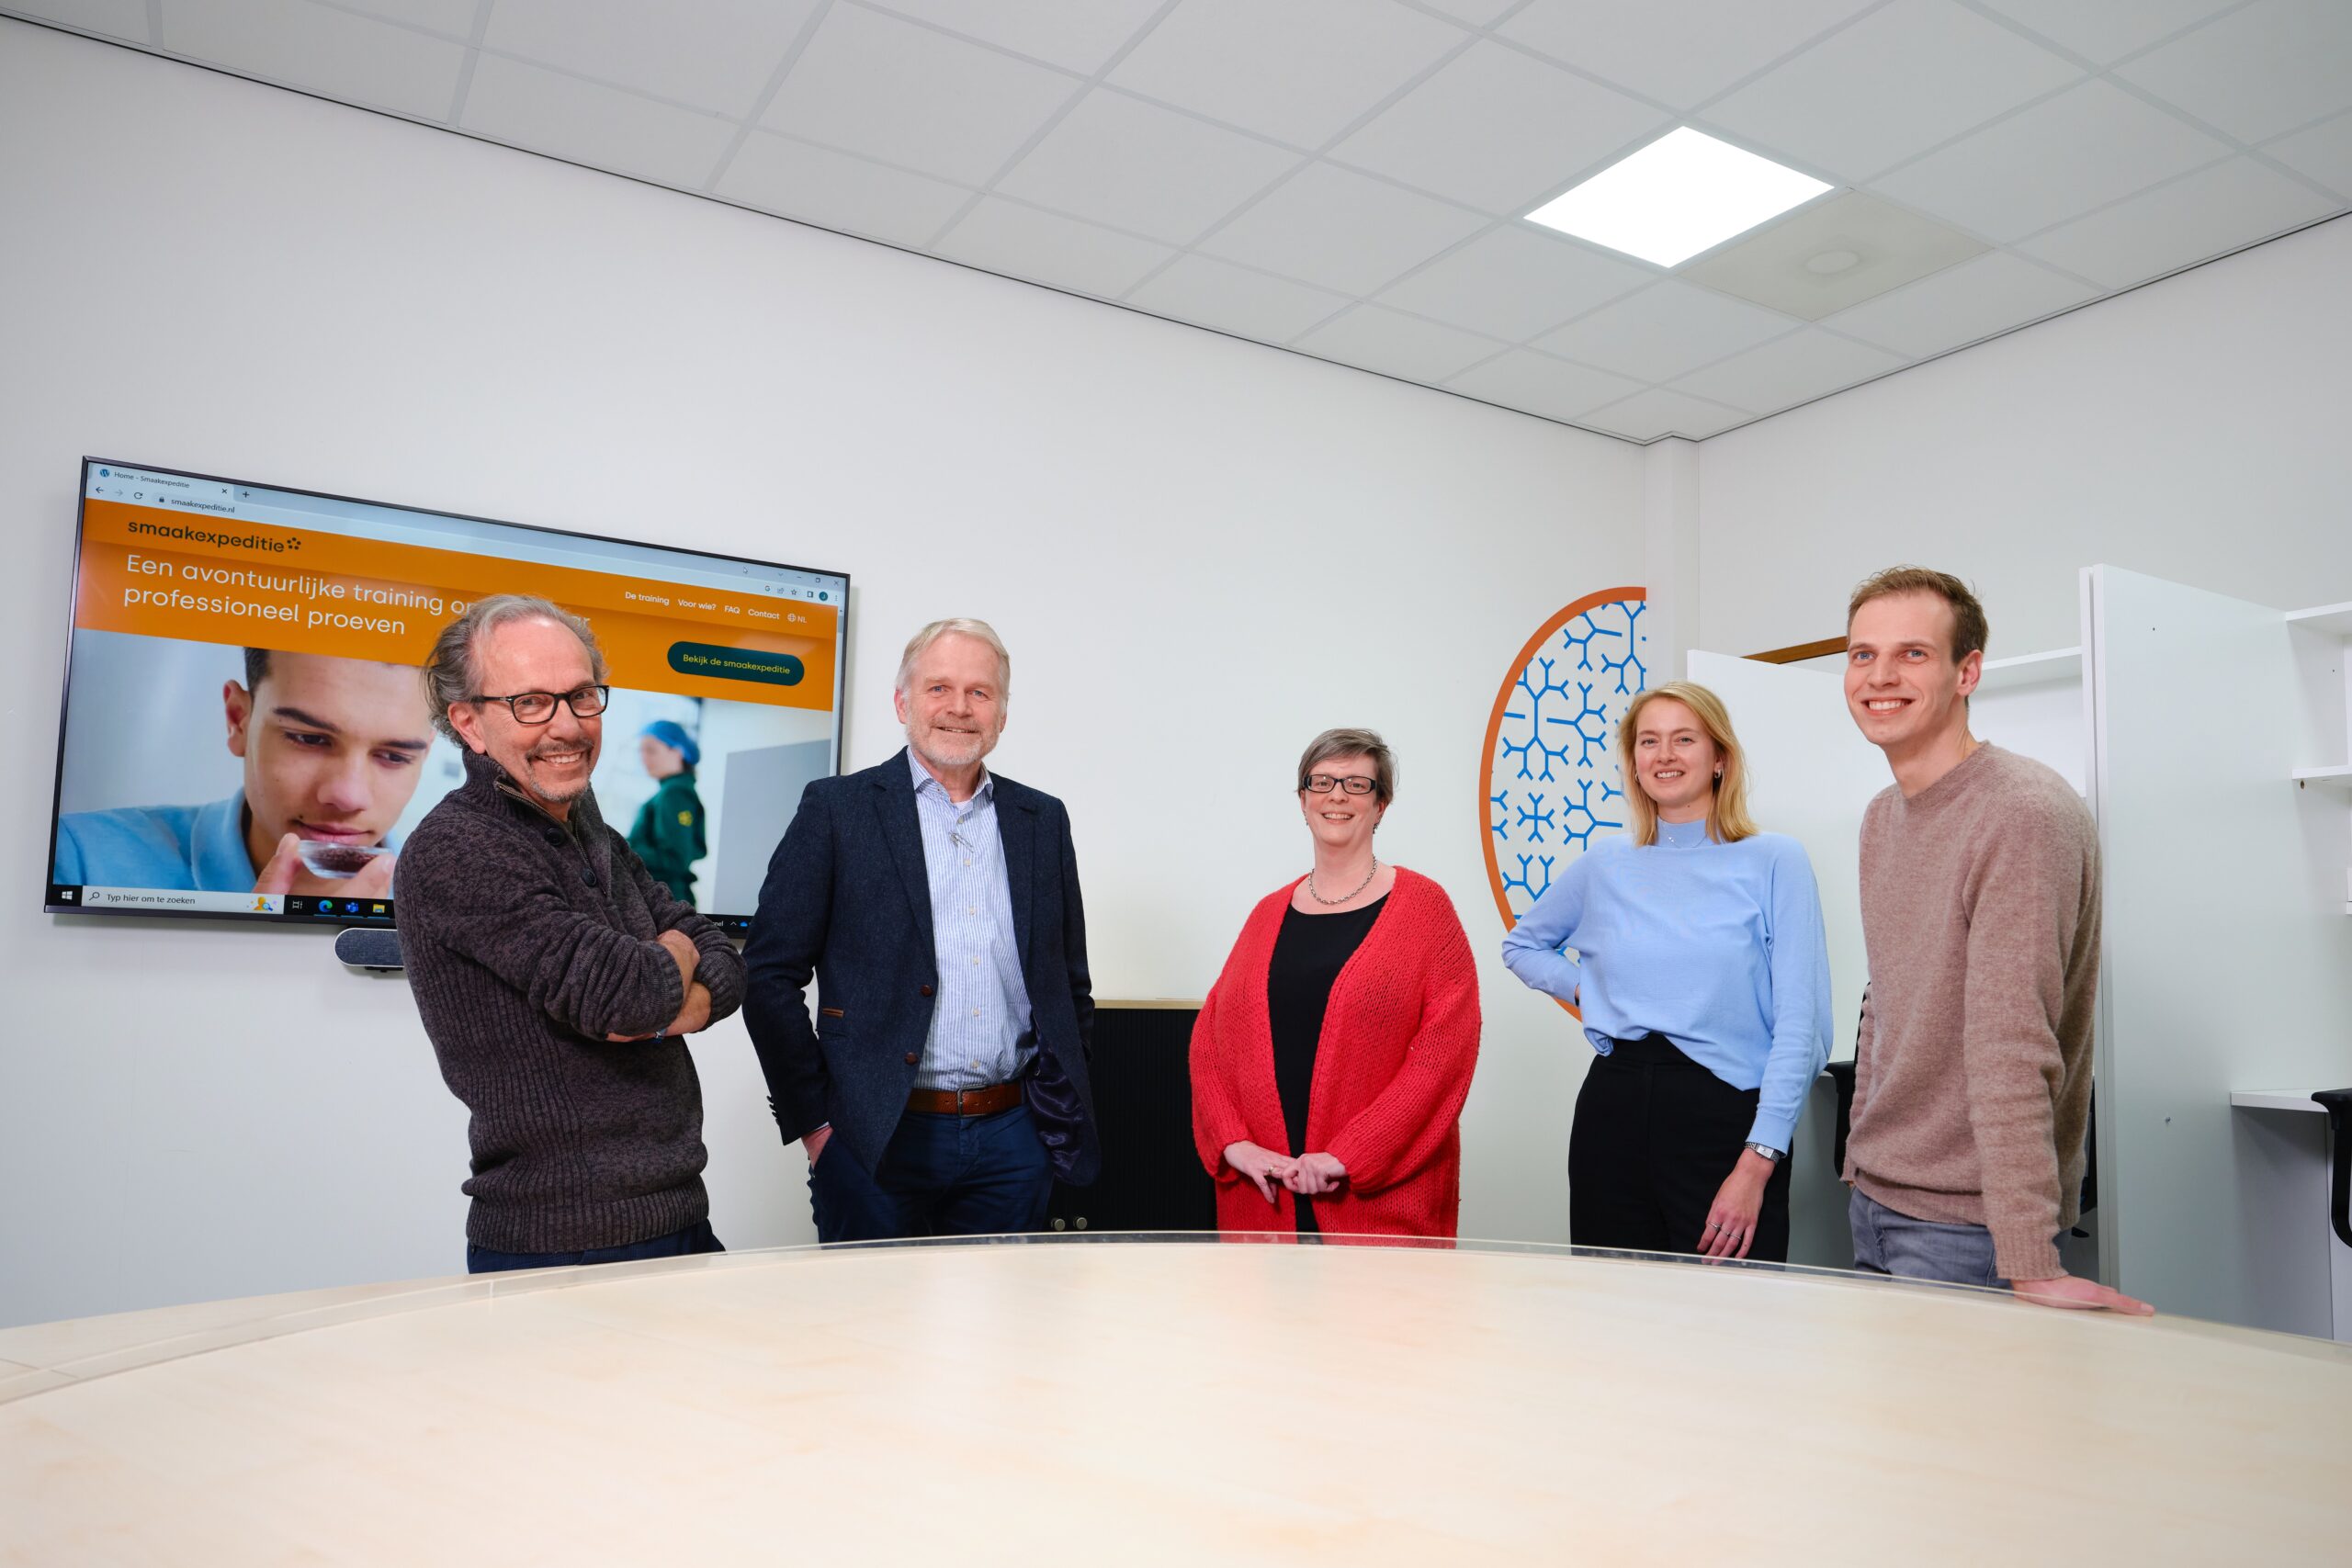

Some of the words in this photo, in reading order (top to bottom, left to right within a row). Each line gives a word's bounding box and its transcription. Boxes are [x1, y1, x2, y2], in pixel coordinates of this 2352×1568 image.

[114, 471, 134, 480] Home
[140, 475, 190, 489] Smaakexpeditie
[171, 499, 235, 513] smaakexpeditie.nl
[128, 520, 285, 553] smaakexpeditie
[127, 554, 173, 577] Een
[182, 563, 345, 601] avontuurlijke
[353, 583, 443, 616] training
[625, 592, 637, 600] De
[639, 593, 670, 606] training
[678, 599, 696, 608] Voor
[698, 602, 717, 611] wie?
[123, 585, 300, 623] professioneel
[308, 608, 405, 635] proeven
[724, 605, 741, 615] FAQ
[748, 608, 780, 620] Contact
[797, 615, 808, 624] NL
[683, 653, 708, 666] Bekijk
[710, 657, 721, 666] de
[723, 660, 791, 674] smaakexpeditie
[107, 894, 121, 903] Typ
[123, 894, 140, 902] hier
[166, 897, 196, 905] zoeken
